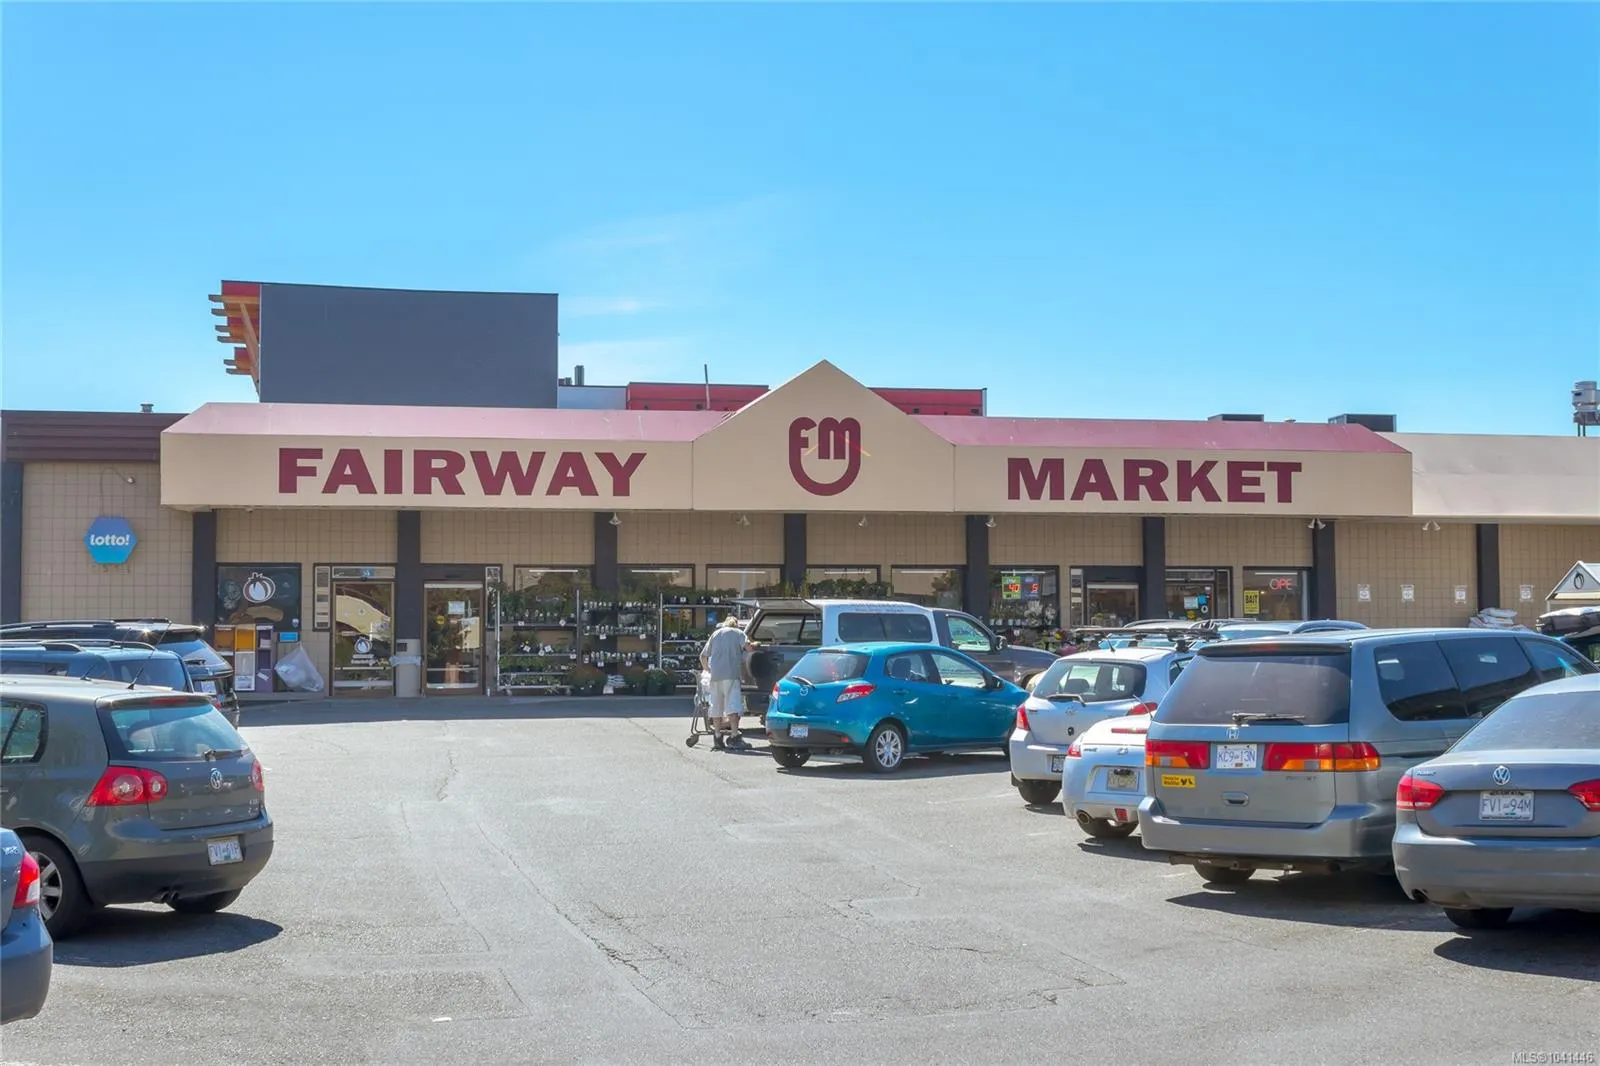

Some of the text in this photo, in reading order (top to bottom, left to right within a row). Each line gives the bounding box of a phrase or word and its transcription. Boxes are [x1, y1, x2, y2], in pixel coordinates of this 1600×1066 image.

[278, 447, 647, 497] FAIRWAY
[1007, 457, 1303, 504] MARKET
[90, 534, 130, 546] lotto!
